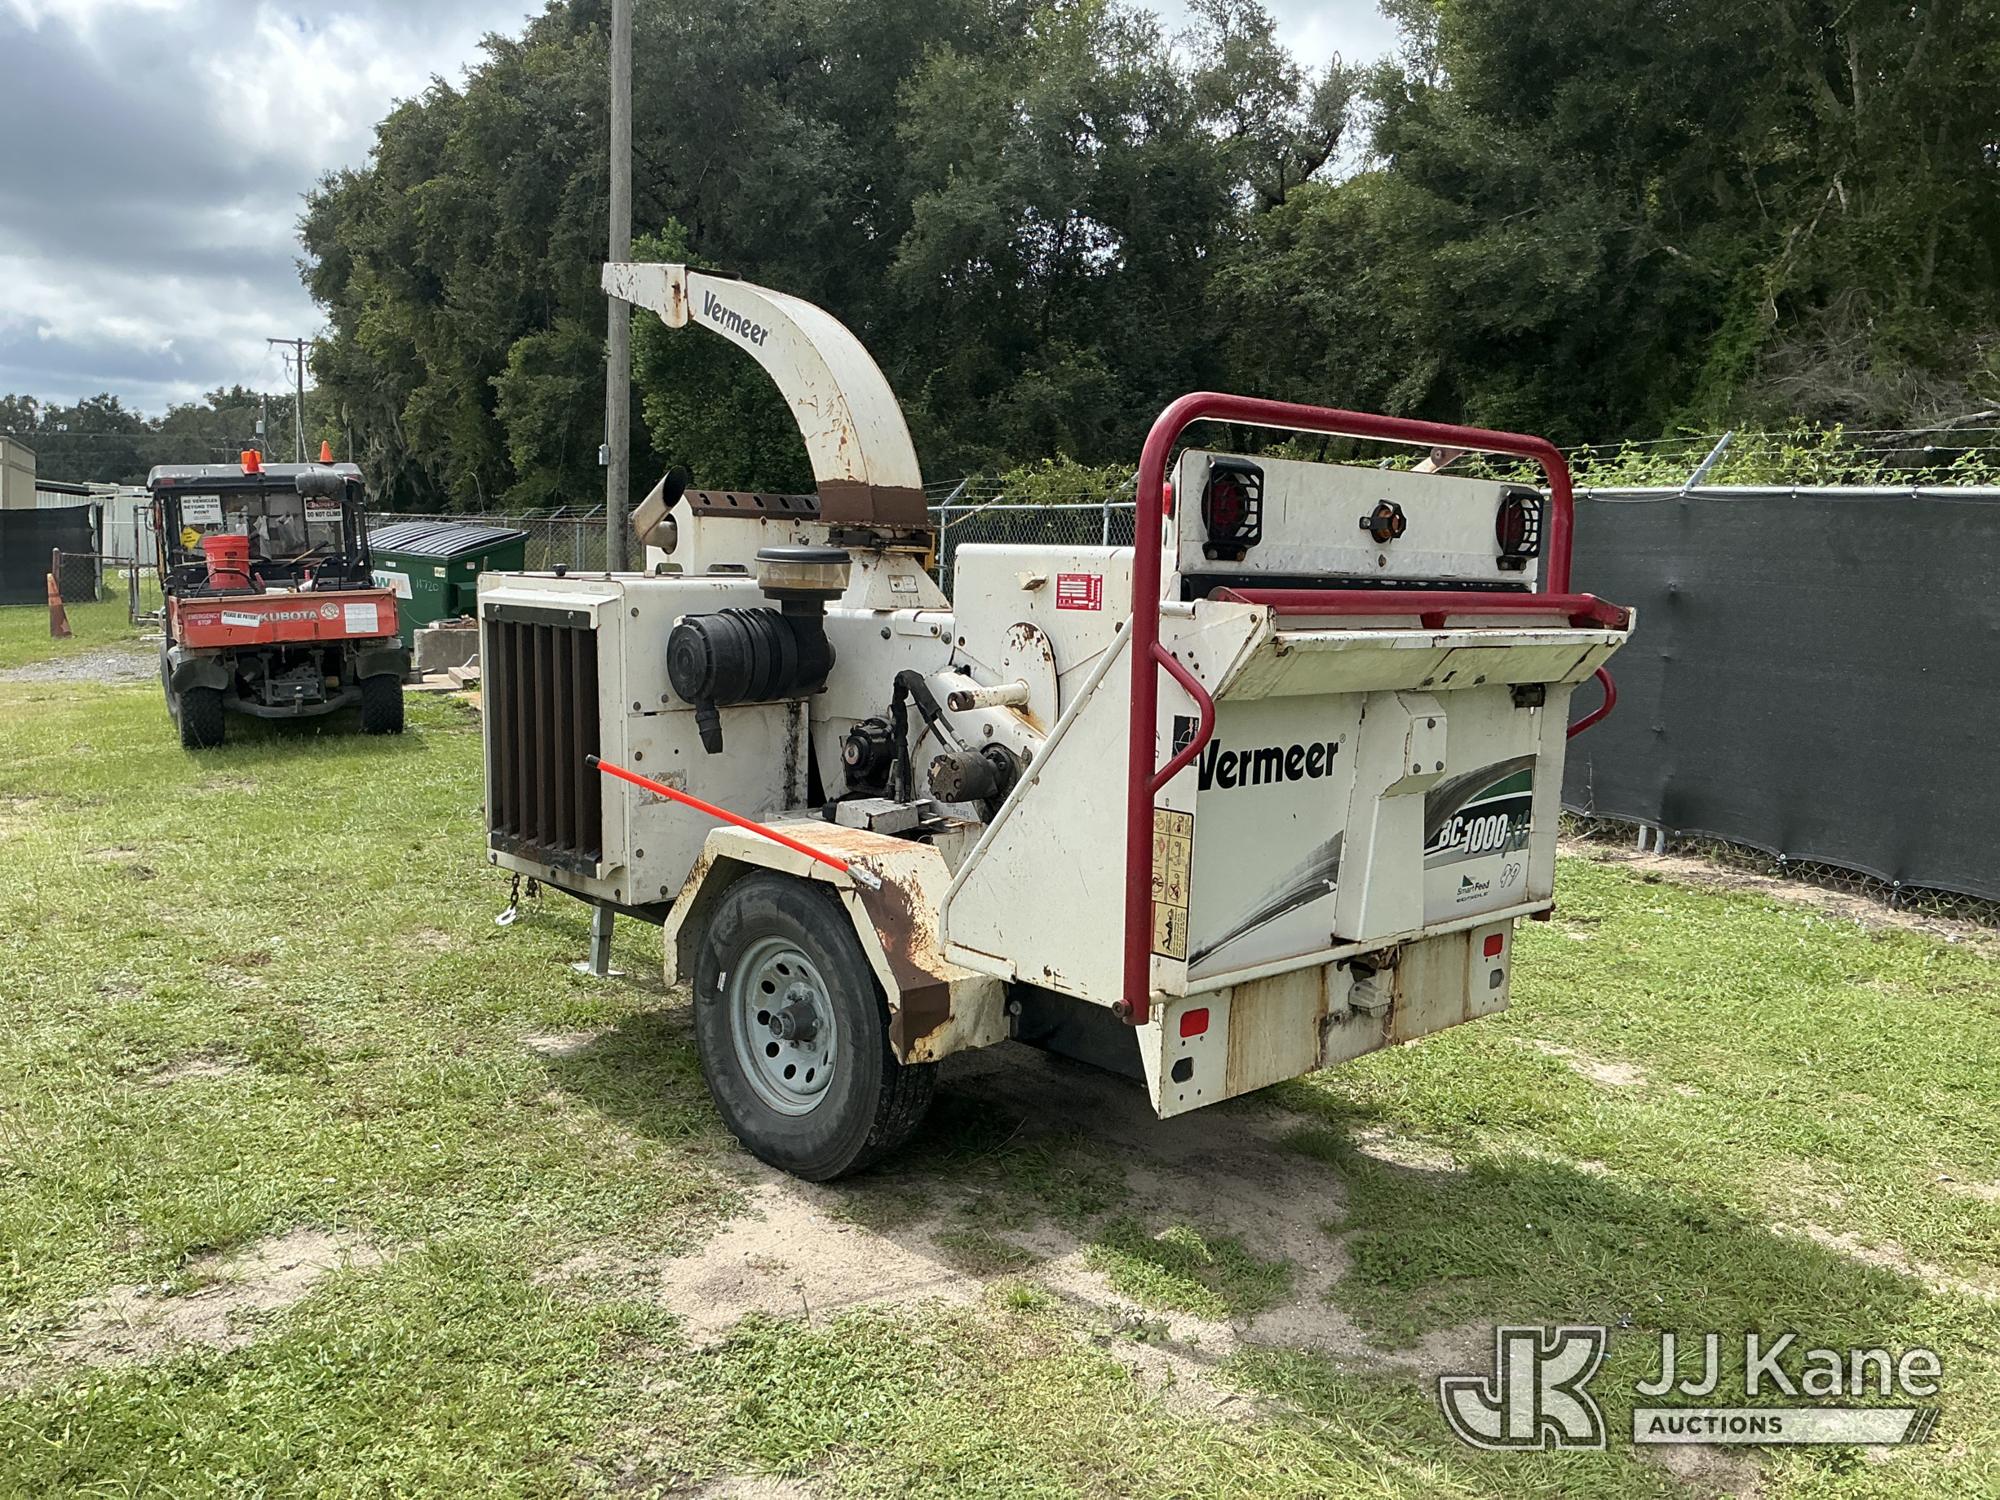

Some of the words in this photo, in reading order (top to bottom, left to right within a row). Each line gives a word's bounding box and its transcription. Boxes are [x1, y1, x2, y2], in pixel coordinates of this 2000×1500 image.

[703, 290, 768, 346] Vermeer
[260, 611, 318, 622] KUBOTA
[1198, 738, 1339, 791] Vermeer
